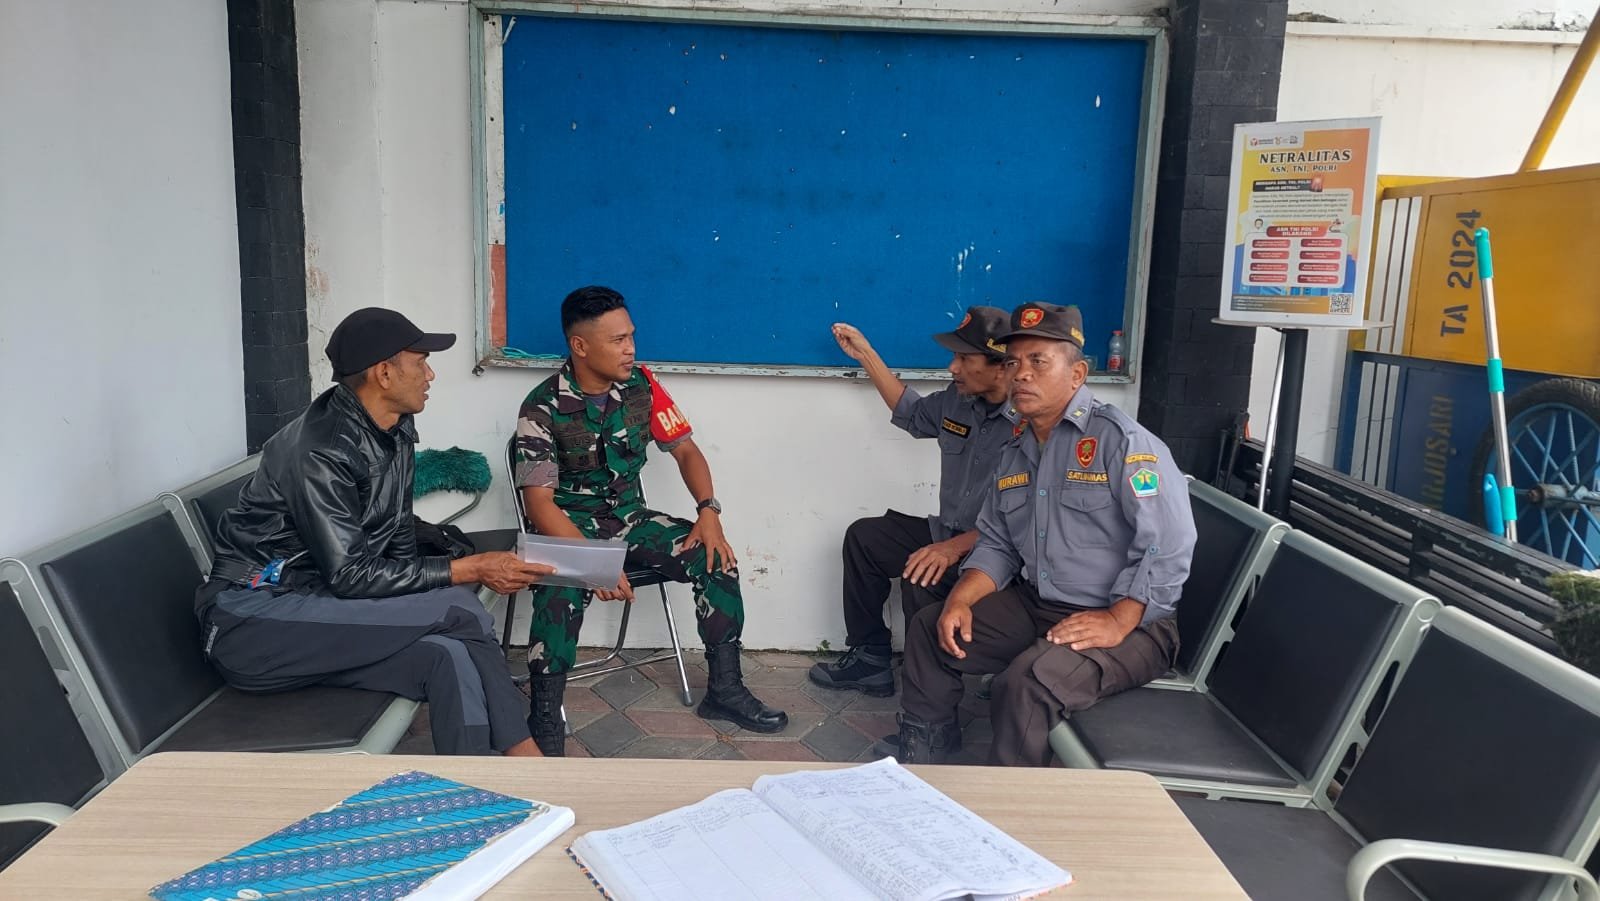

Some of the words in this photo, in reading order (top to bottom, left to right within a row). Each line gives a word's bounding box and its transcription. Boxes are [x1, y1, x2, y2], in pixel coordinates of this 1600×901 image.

[1259, 150, 1351, 164] NETRALITAS
[1312, 164, 1337, 172] POLRI
[1447, 209, 1481, 289] 2024
[1440, 304, 1469, 337] TA
